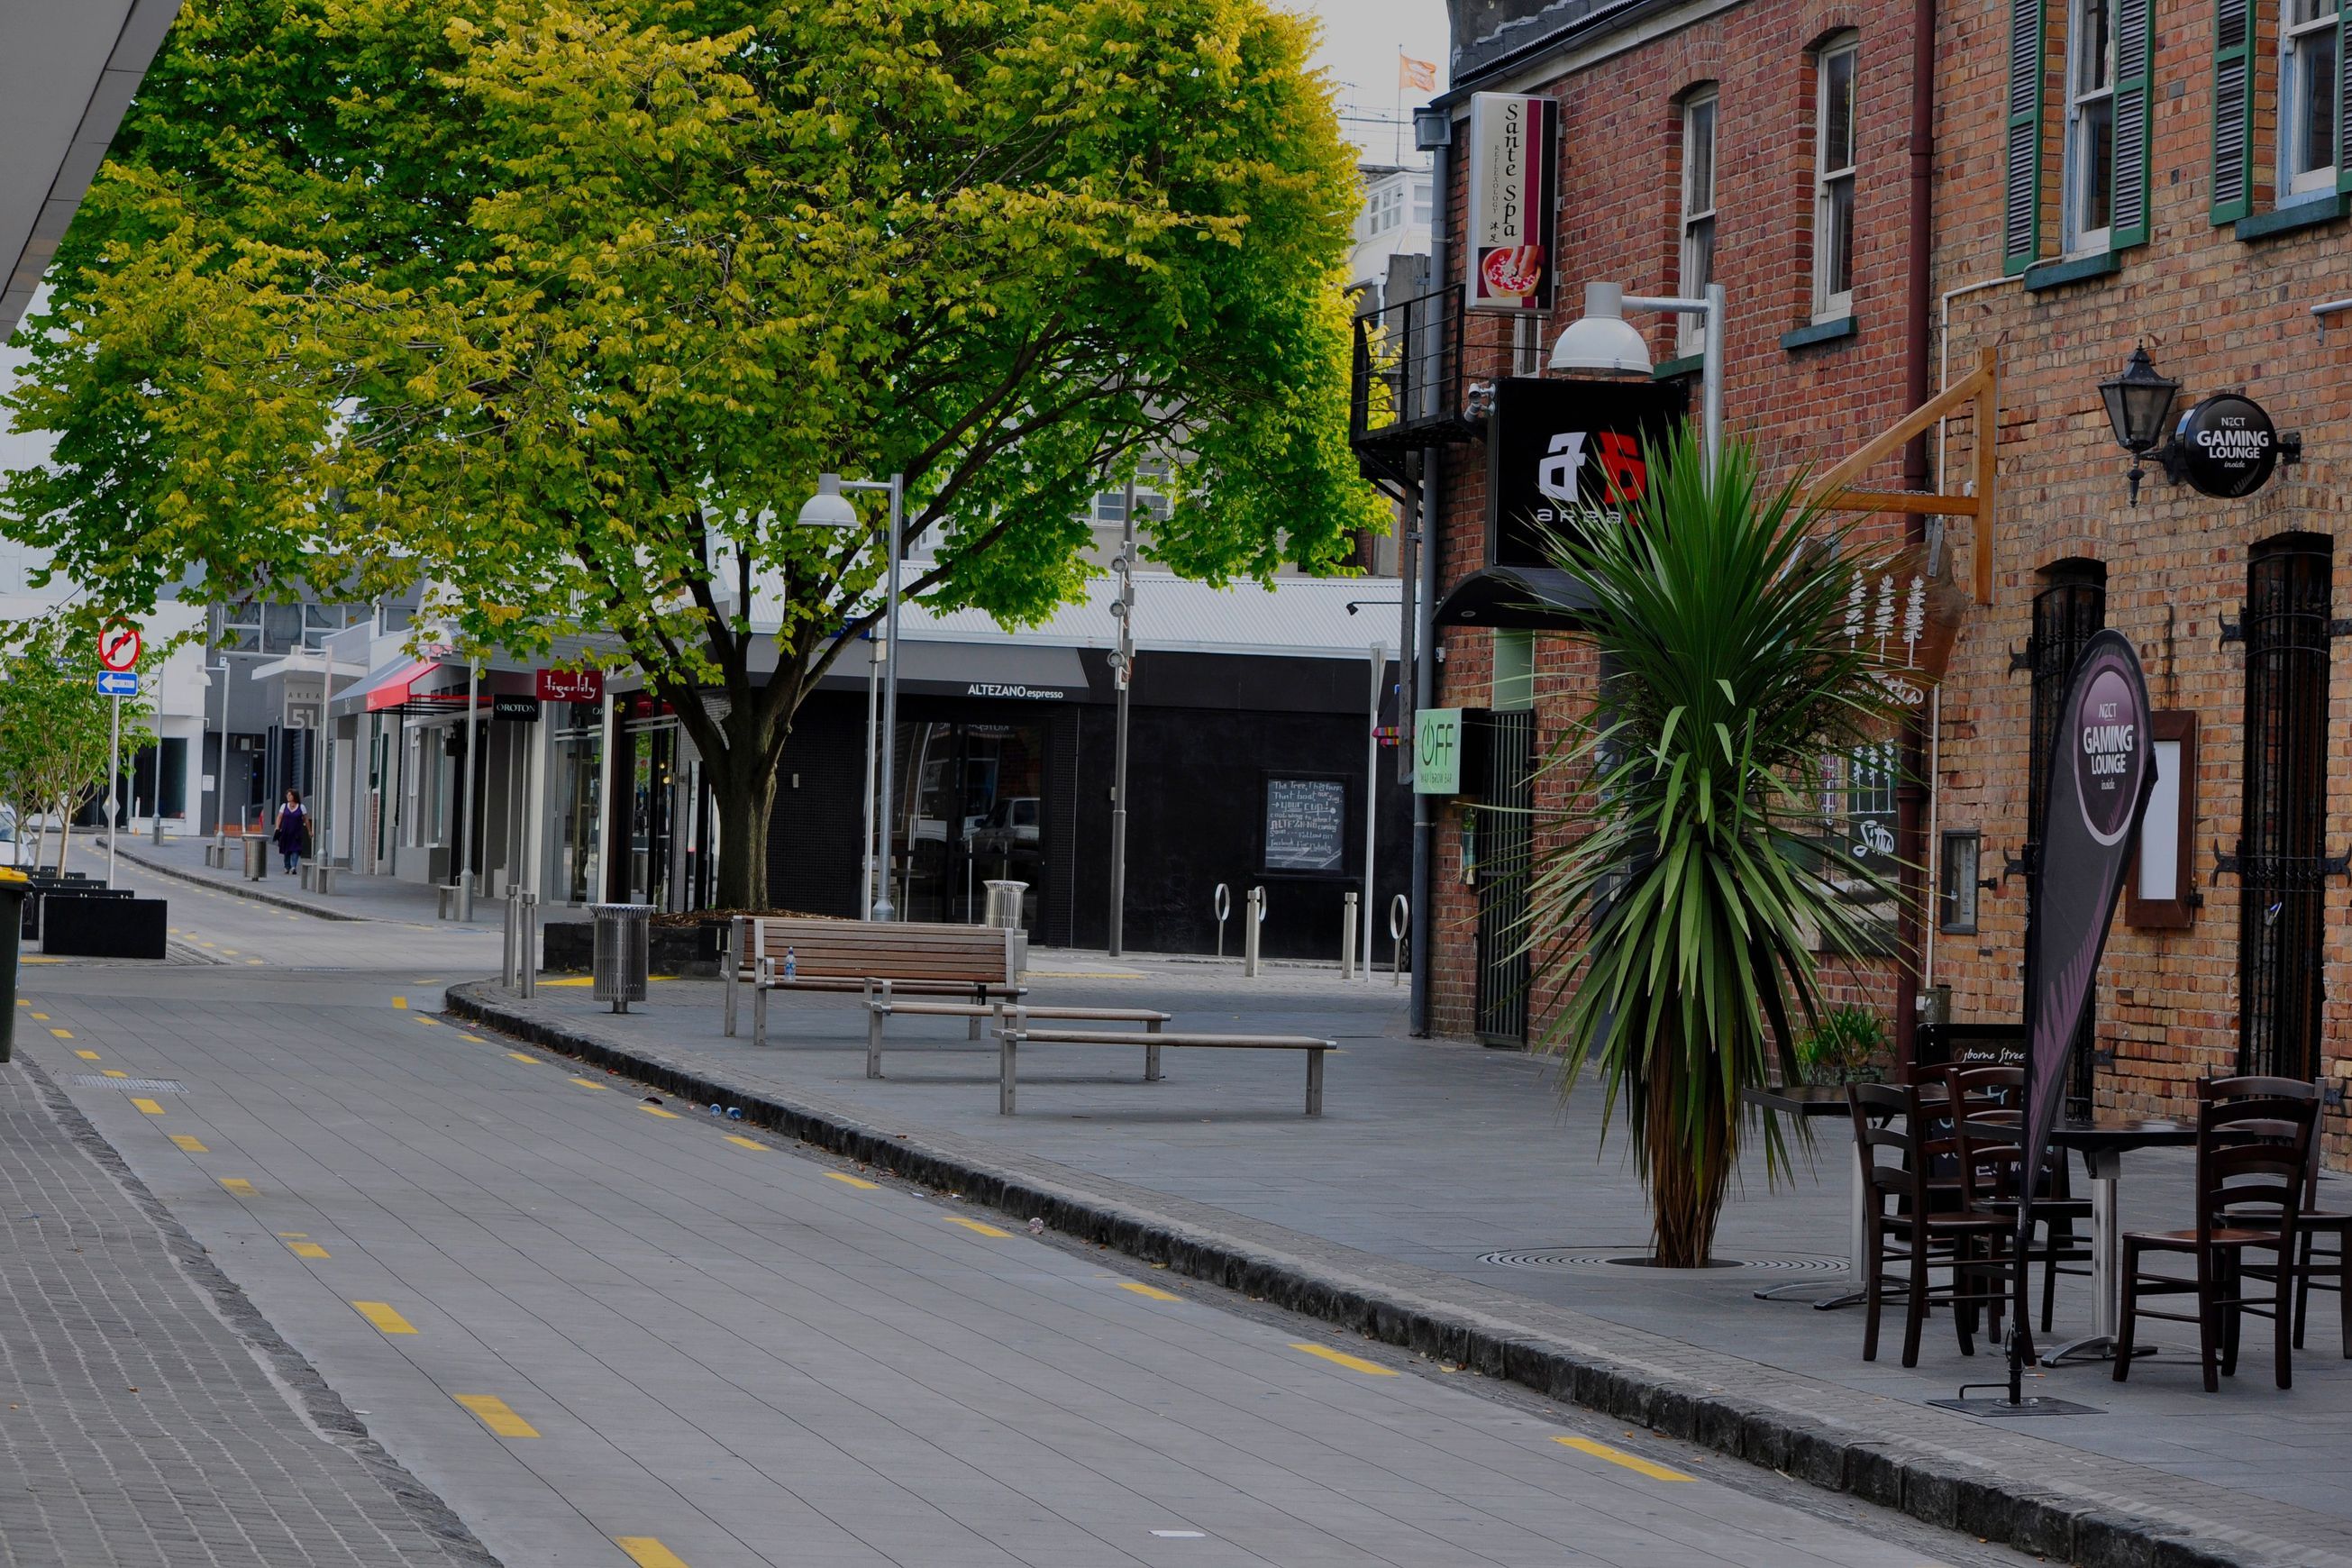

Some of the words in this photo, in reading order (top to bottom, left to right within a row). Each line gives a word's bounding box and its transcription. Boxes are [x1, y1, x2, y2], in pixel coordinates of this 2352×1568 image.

[1503, 103, 1520, 177] Sante
[1491, 144, 1500, 214] REFLEXOLOGY
[1502, 185, 1518, 237] Spa
[2220, 417, 2246, 427] NZCT
[2196, 430, 2269, 447] GAMING
[2209, 447, 2260, 459] LOUNGE
[543, 674, 597, 699] tigerlily
[967, 684, 1026, 697] ALTEZANO
[1026, 690, 1063, 699] espresso
[497, 704, 535, 712] OROTON
[293, 709, 319, 729] 51
[1421, 717, 1454, 766] OFF
[2083, 725, 2134, 754] GAMING
[2092, 753, 2126, 774] LOUNGE
[1954, 1047, 1995, 1063] Osborne
[1998, 1047, 2026, 1063] Stree
